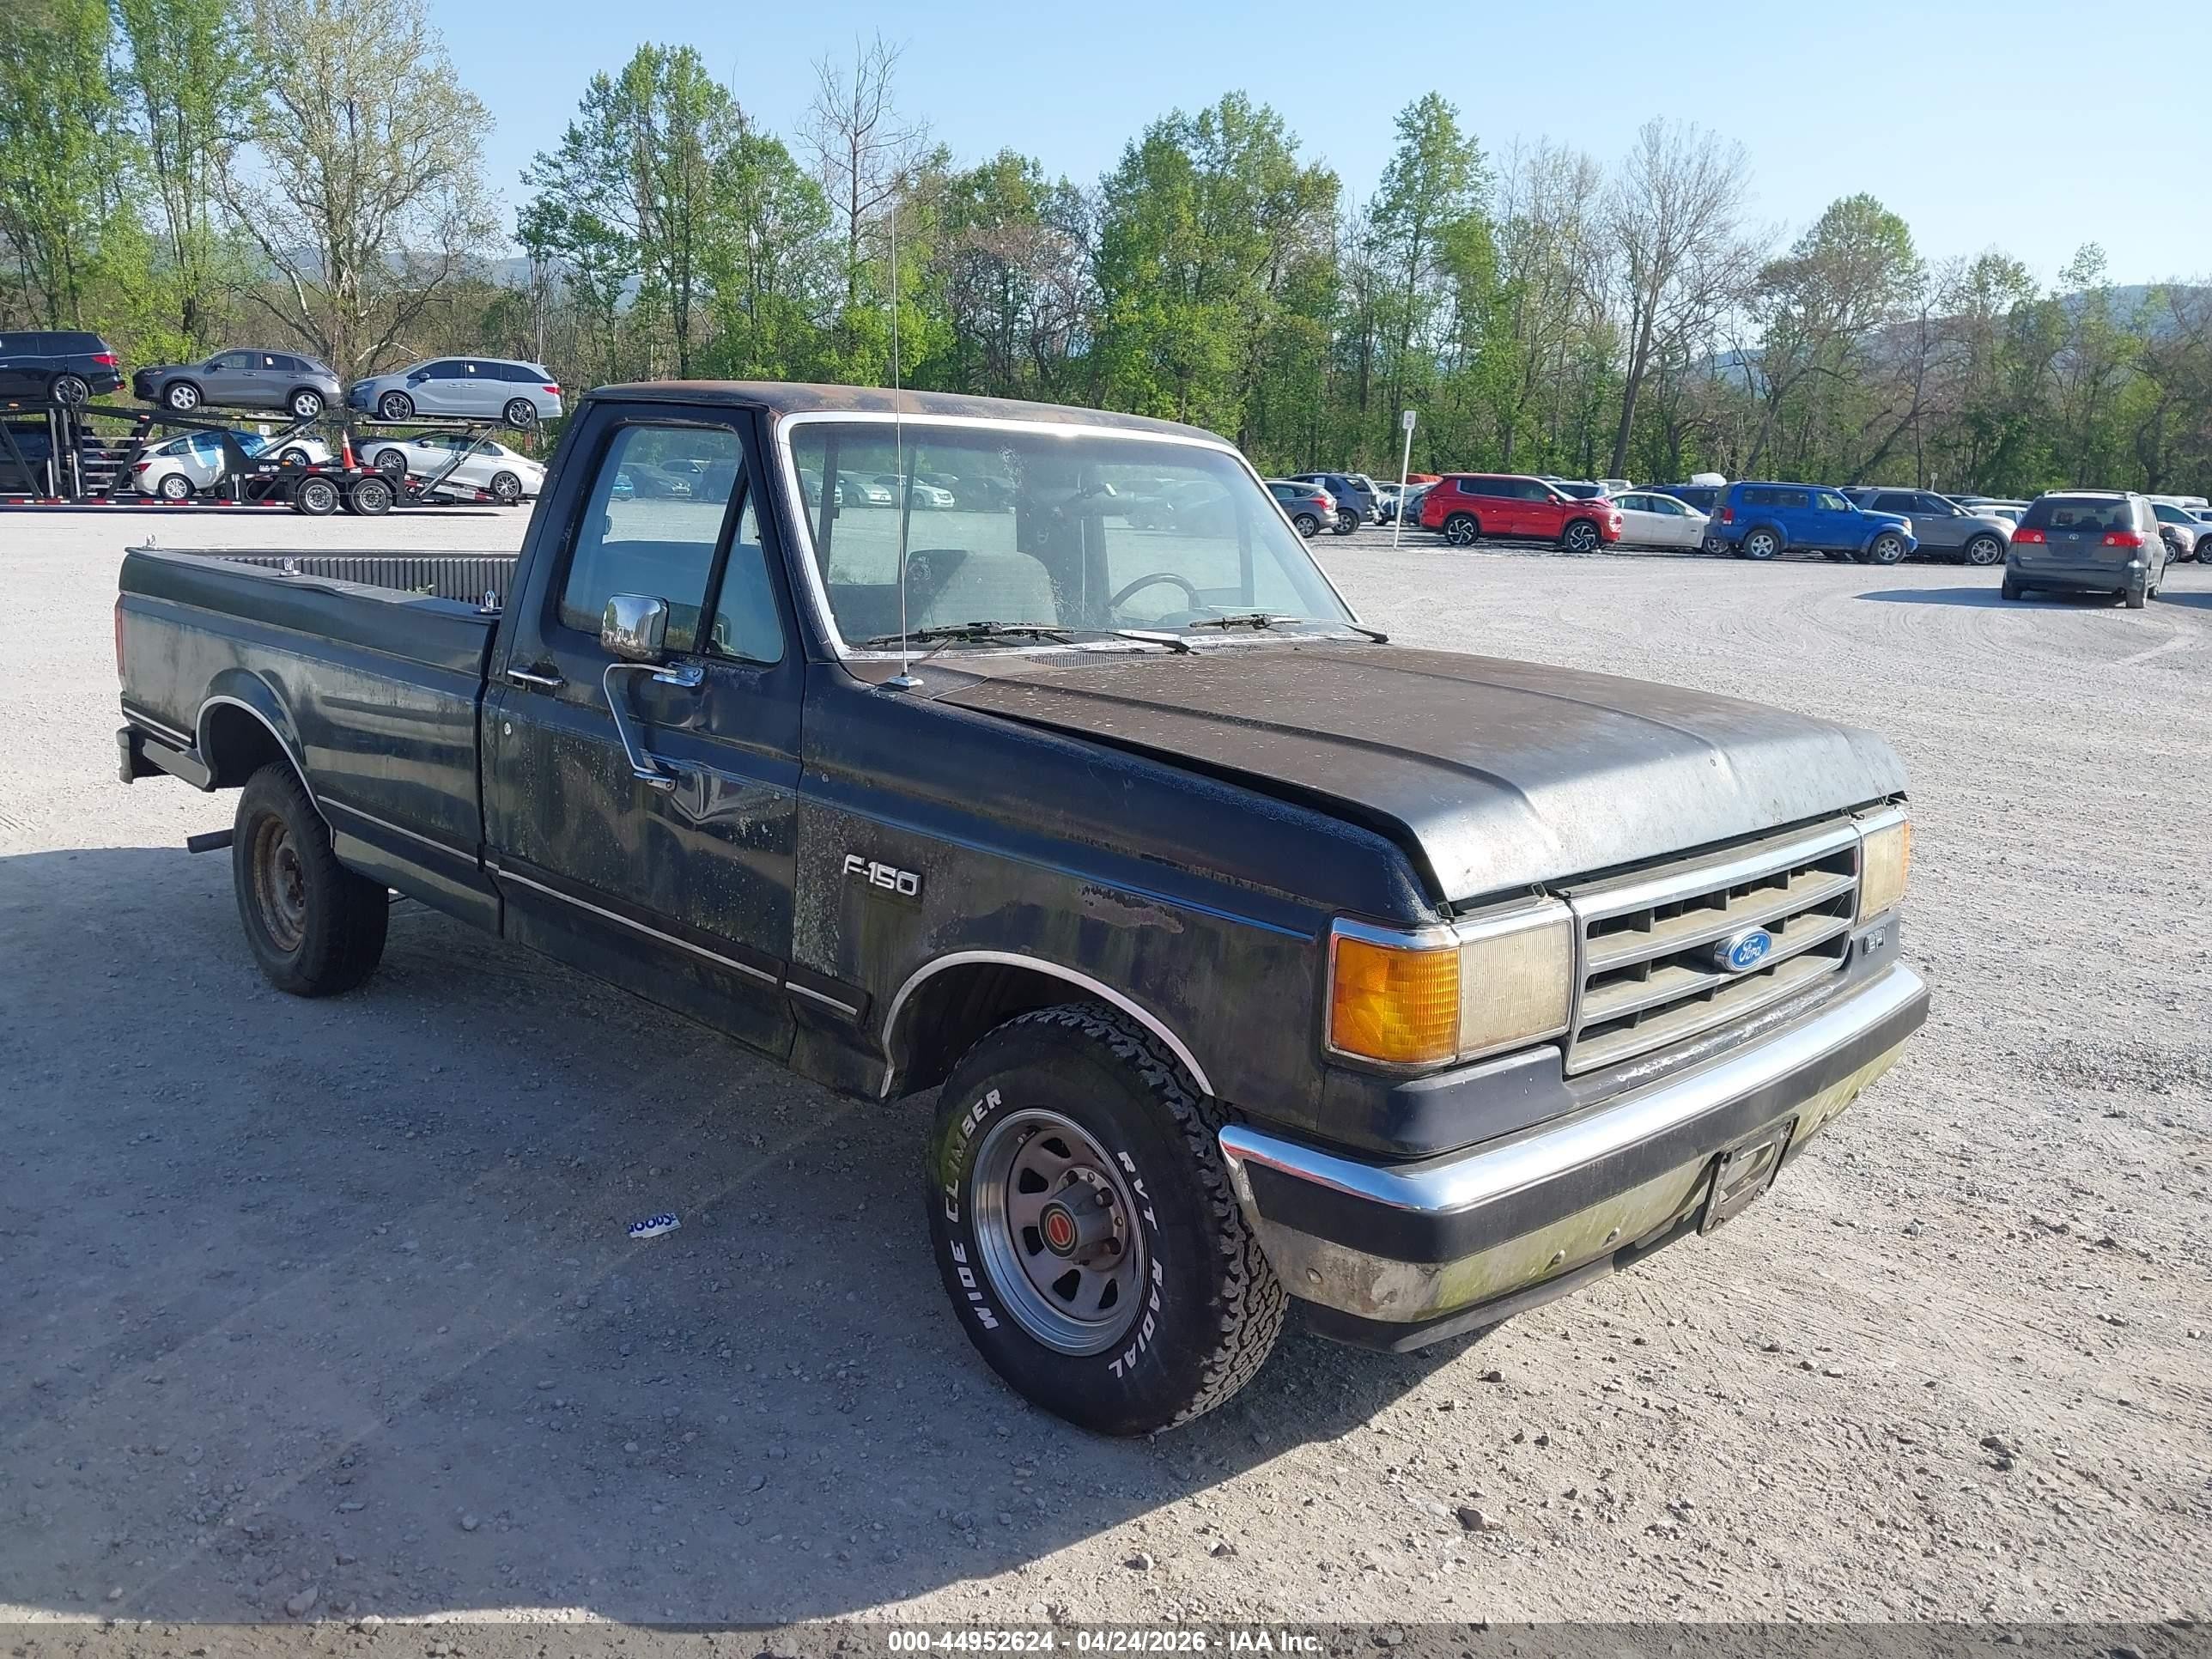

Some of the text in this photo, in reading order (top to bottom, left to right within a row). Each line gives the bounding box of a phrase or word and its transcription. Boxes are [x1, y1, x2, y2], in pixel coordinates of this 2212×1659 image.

[843, 854, 921, 896] F-150
[1739, 938, 1764, 963] Ford
[945, 1088, 1002, 1330] WIDE CLIMBER
[1108, 1151, 1163, 1379] RVT RADIAL
